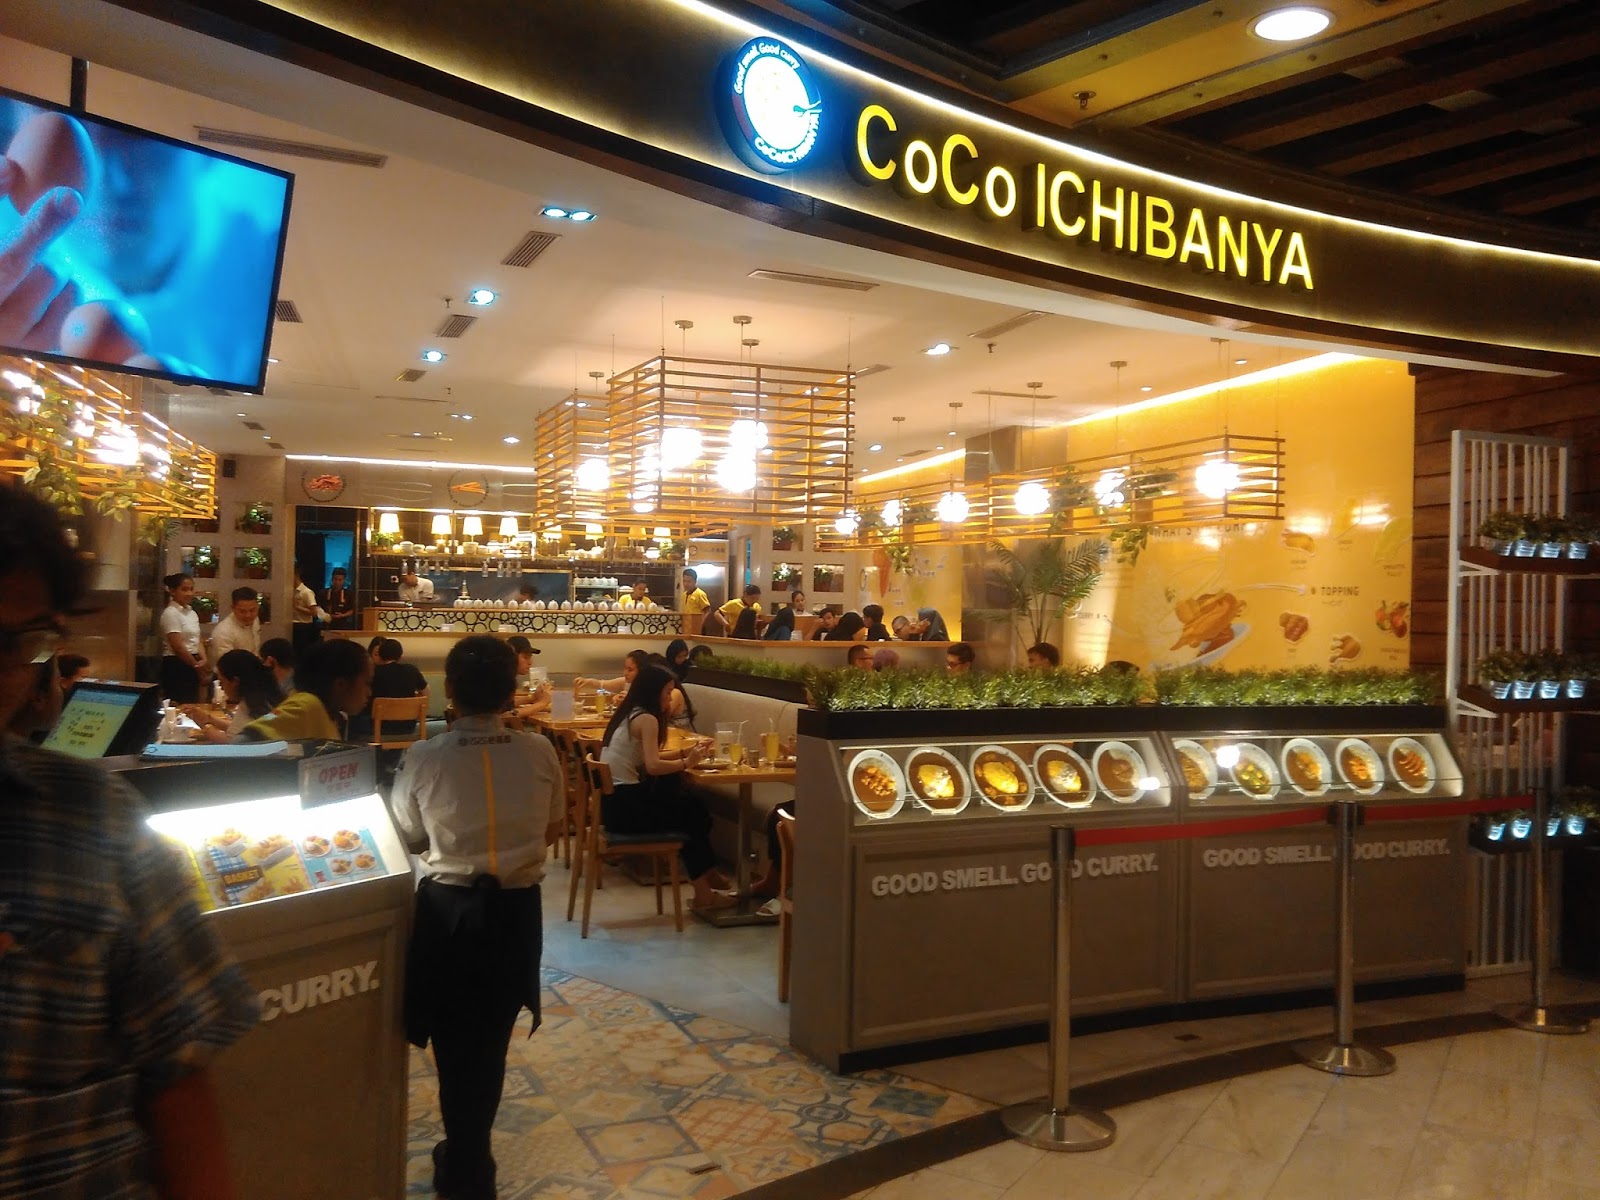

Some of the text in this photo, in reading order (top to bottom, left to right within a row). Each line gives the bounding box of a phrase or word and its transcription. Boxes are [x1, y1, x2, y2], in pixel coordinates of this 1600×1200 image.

[855, 104, 1314, 290] CoCo ICHIBANYA
[1321, 586, 1360, 596] TOPPING
[318, 761, 360, 784] OPEN
[871, 852, 1159, 897] GOOD SMELL. GOD CURRY.
[1203, 847, 1261, 868] GOOD
[256, 960, 381, 1021] CURRY.
